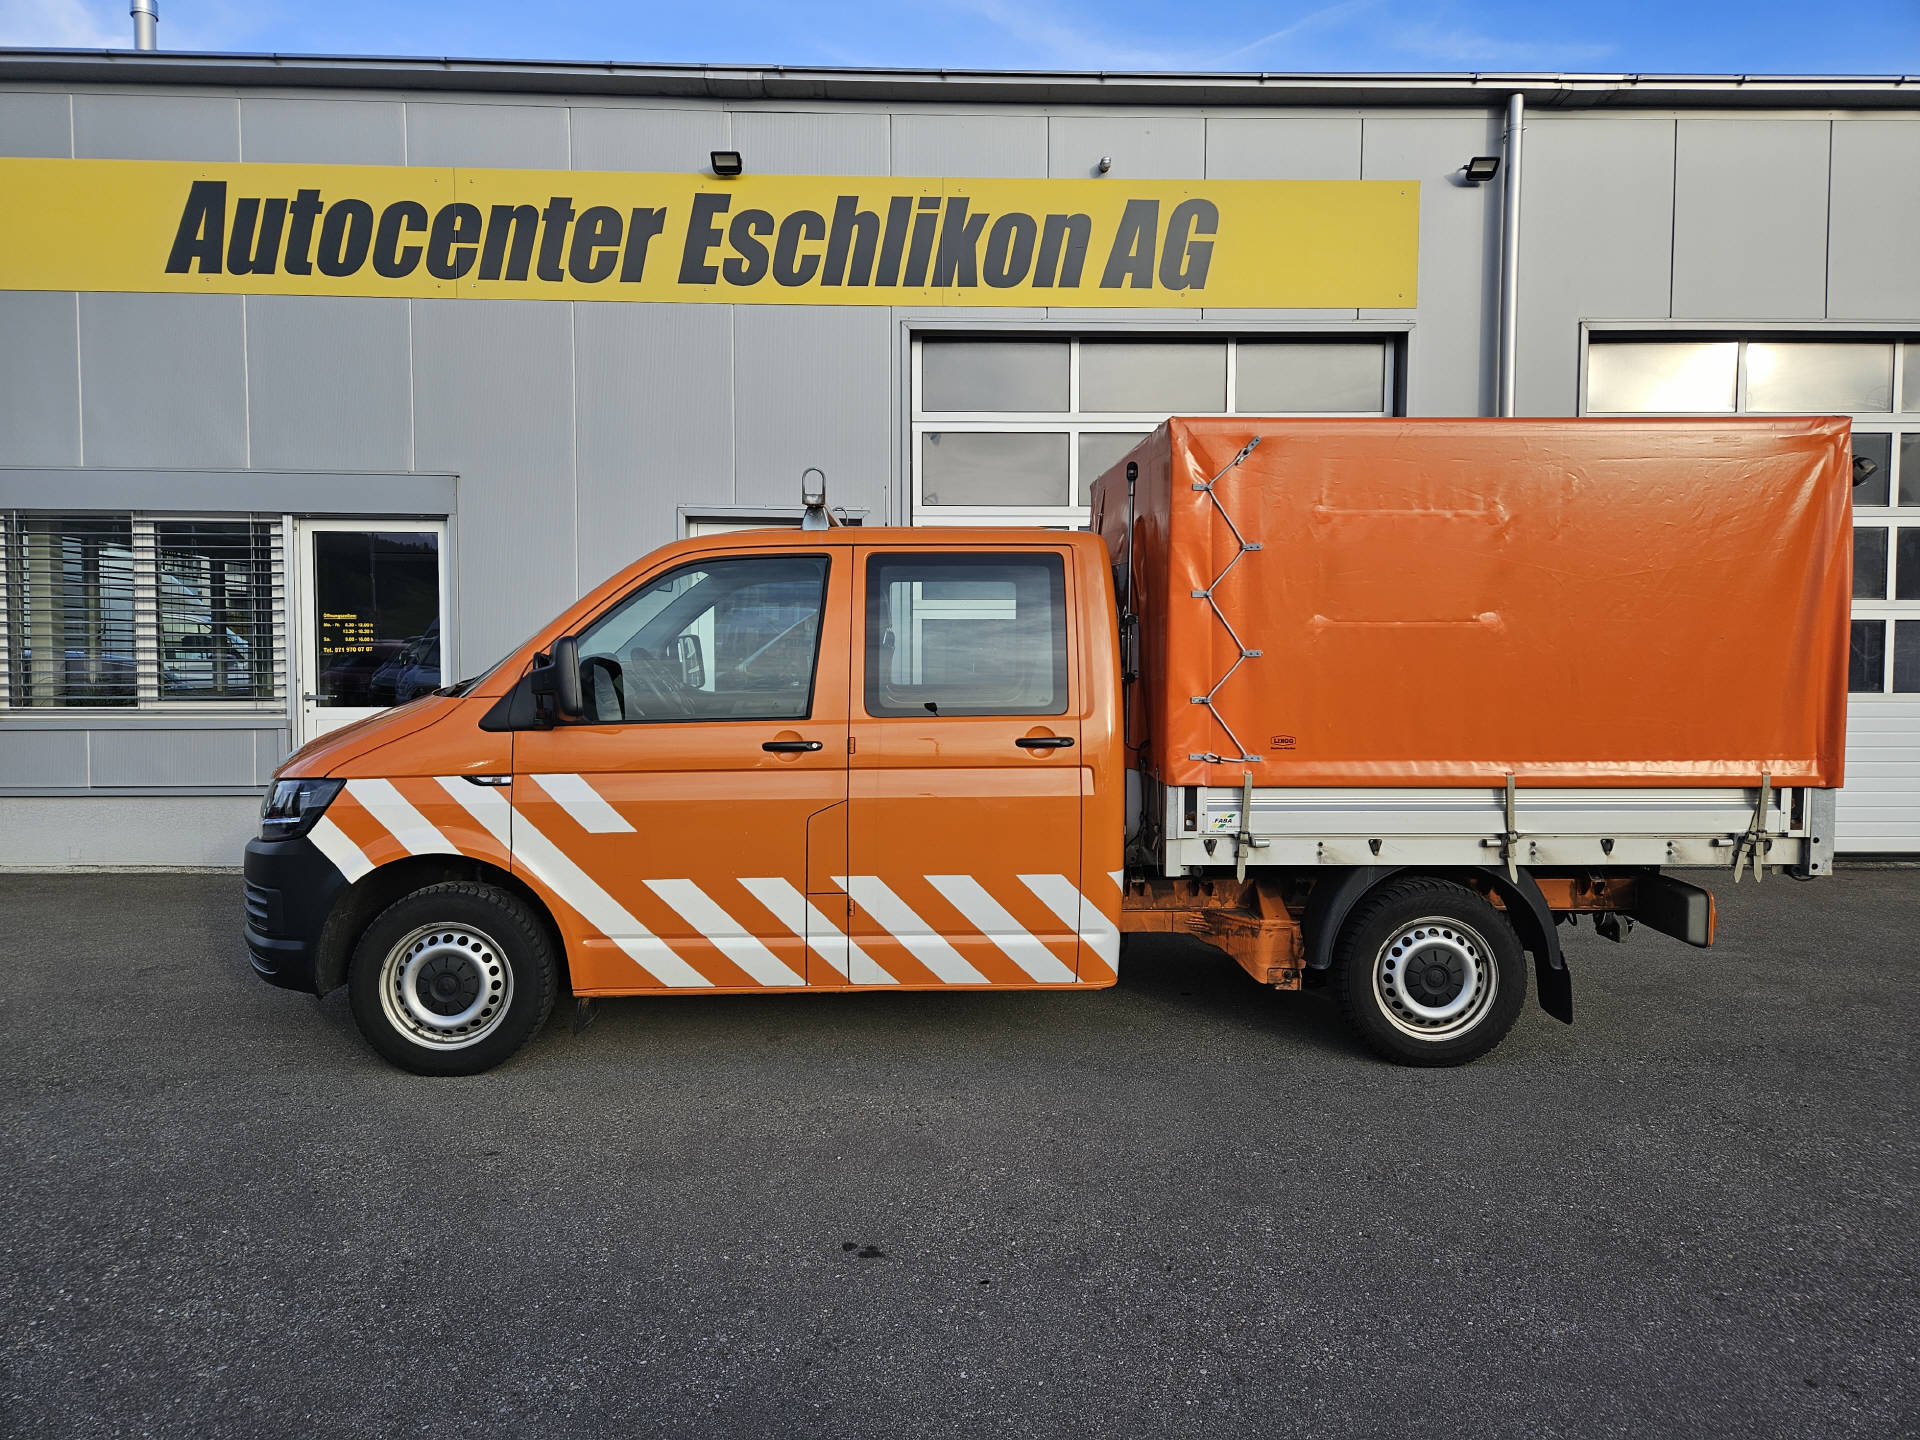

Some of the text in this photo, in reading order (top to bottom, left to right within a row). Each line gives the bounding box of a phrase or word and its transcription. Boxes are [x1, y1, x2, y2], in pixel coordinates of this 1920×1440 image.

[165, 181, 1219, 291] Autocenter Eschlikon AG
